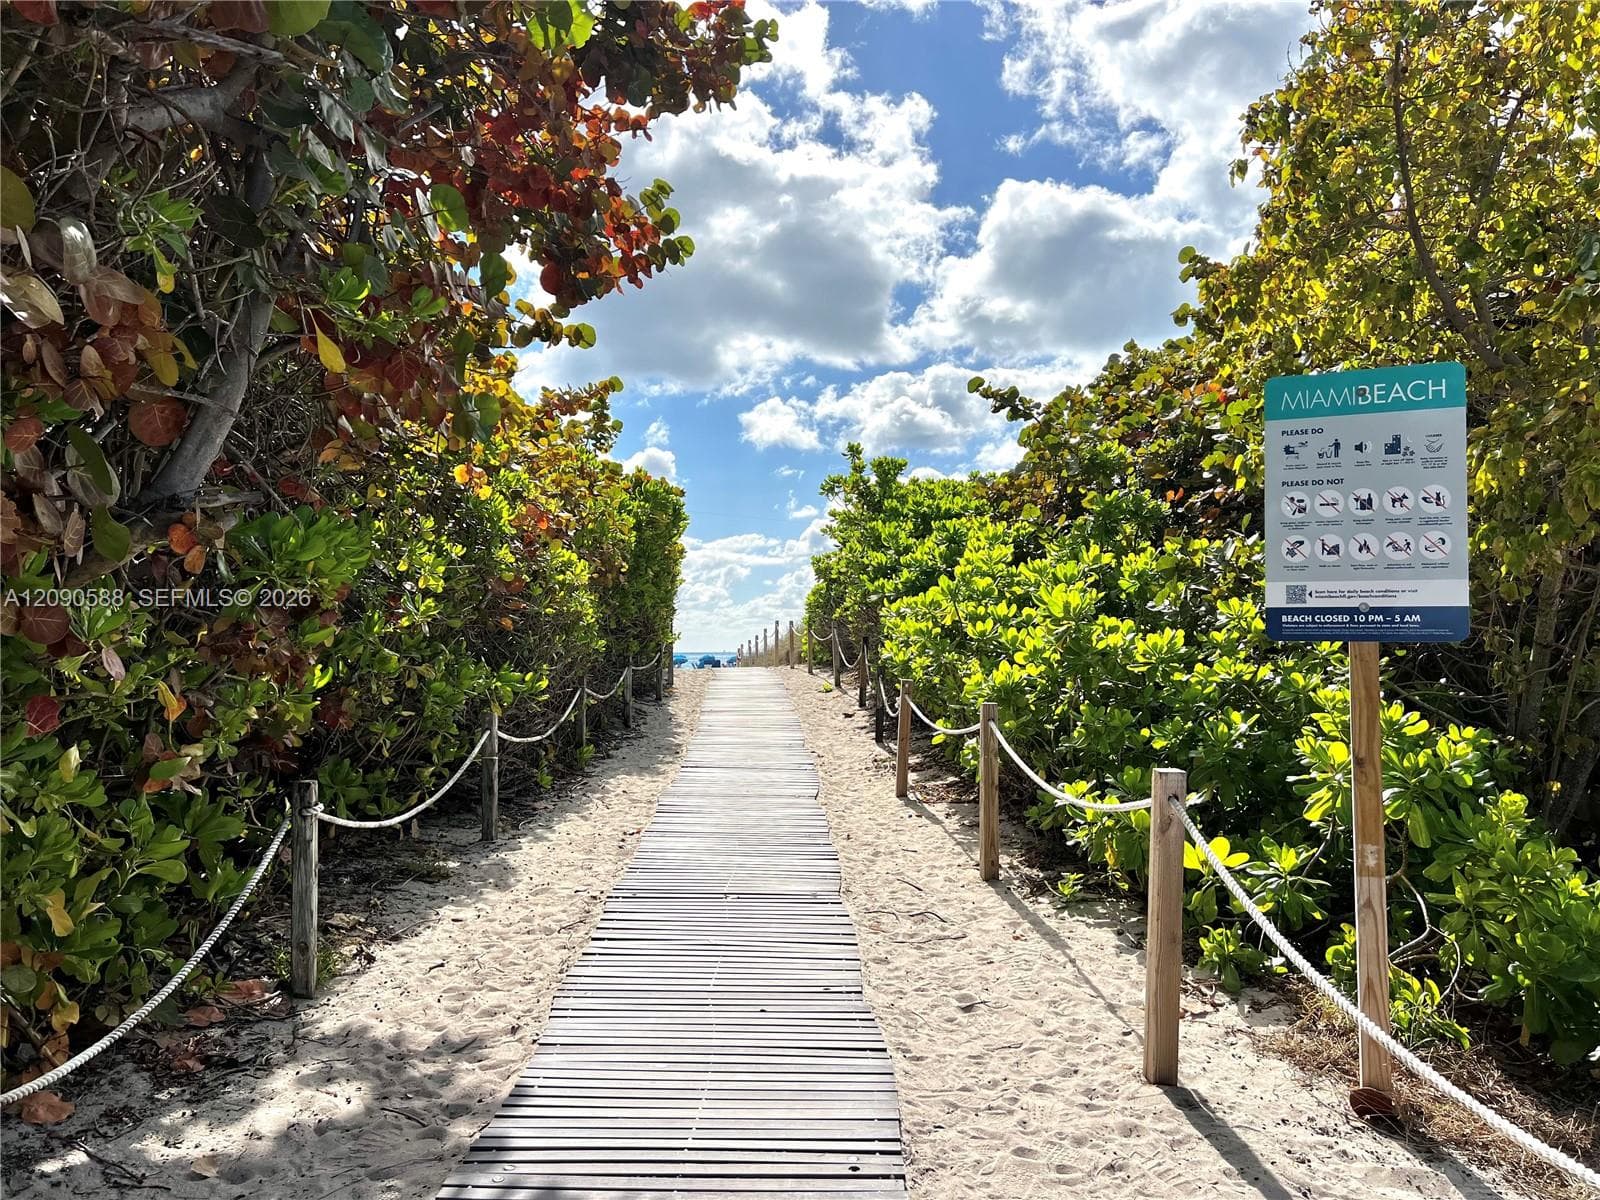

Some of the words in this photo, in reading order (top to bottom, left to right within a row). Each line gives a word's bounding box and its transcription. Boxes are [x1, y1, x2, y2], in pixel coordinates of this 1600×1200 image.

[1281, 428, 1309, 437] PLEASE
[1311, 427, 1324, 436] DO
[1281, 479, 1309, 487] PLEASE
[1311, 478, 1324, 486] DO
[1327, 478, 1345, 486] NOT
[1281, 614, 1312, 623] BEACH
[1314, 614, 1350, 623] CLOSED
[1353, 614, 1366, 623] 10
[1368, 614, 1384, 623] PM
[1394, 614, 1401, 623] 5
[1403, 614, 1421, 623] AM
